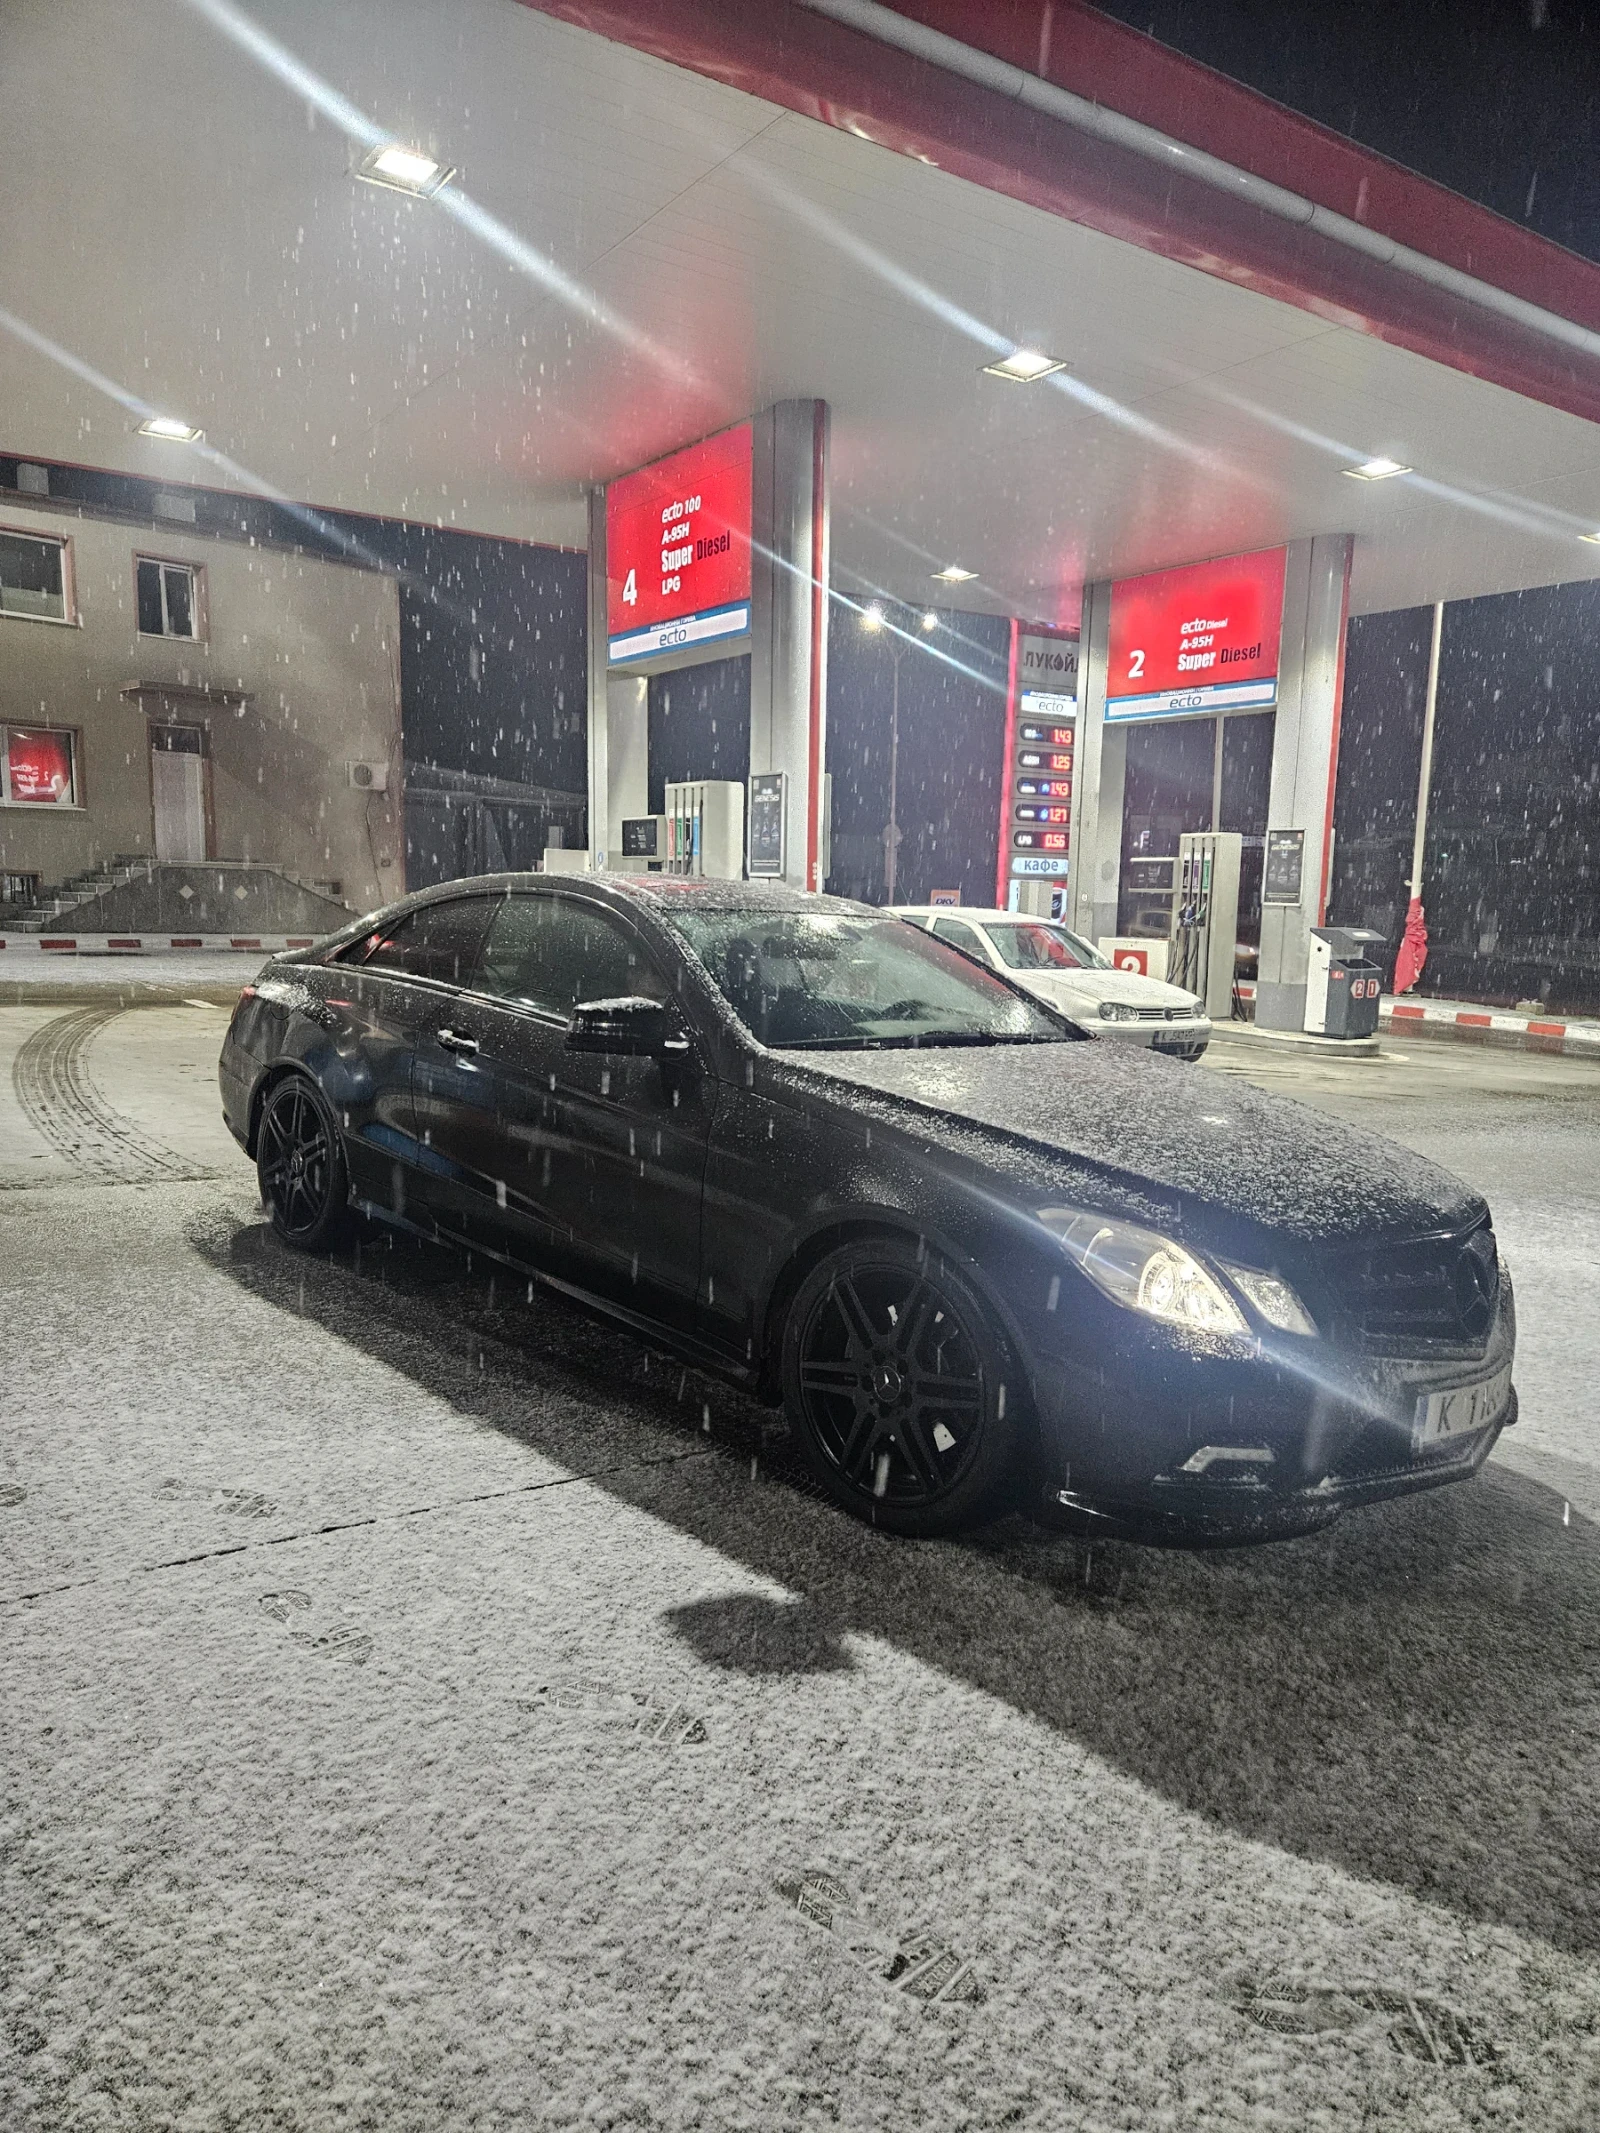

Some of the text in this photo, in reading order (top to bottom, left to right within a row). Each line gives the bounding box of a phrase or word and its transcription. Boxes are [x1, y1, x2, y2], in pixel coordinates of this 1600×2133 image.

[661, 495, 702, 524] ecto 100
[661, 522, 690, 545] A-95H
[661, 530, 731, 573] Super Diesel
[622, 568, 638, 606] 4
[661, 575, 681, 595] LPG
[1180, 618, 1206, 635] ecto
[659, 628, 687, 647] ecto
[1179, 635, 1214, 651] A-95H
[1128, 650, 1146, 679] 2
[1177, 642, 1261, 671] Super Diesel
[1038, 700, 1064, 713] ecto
[1169, 694, 1202, 709] ecto
[1024, 859, 1059, 873] кафе
[1120, 955, 1142, 976] 2
[1356, 983, 1375, 994] 2 1
[1437, 1394, 1456, 1433] K
